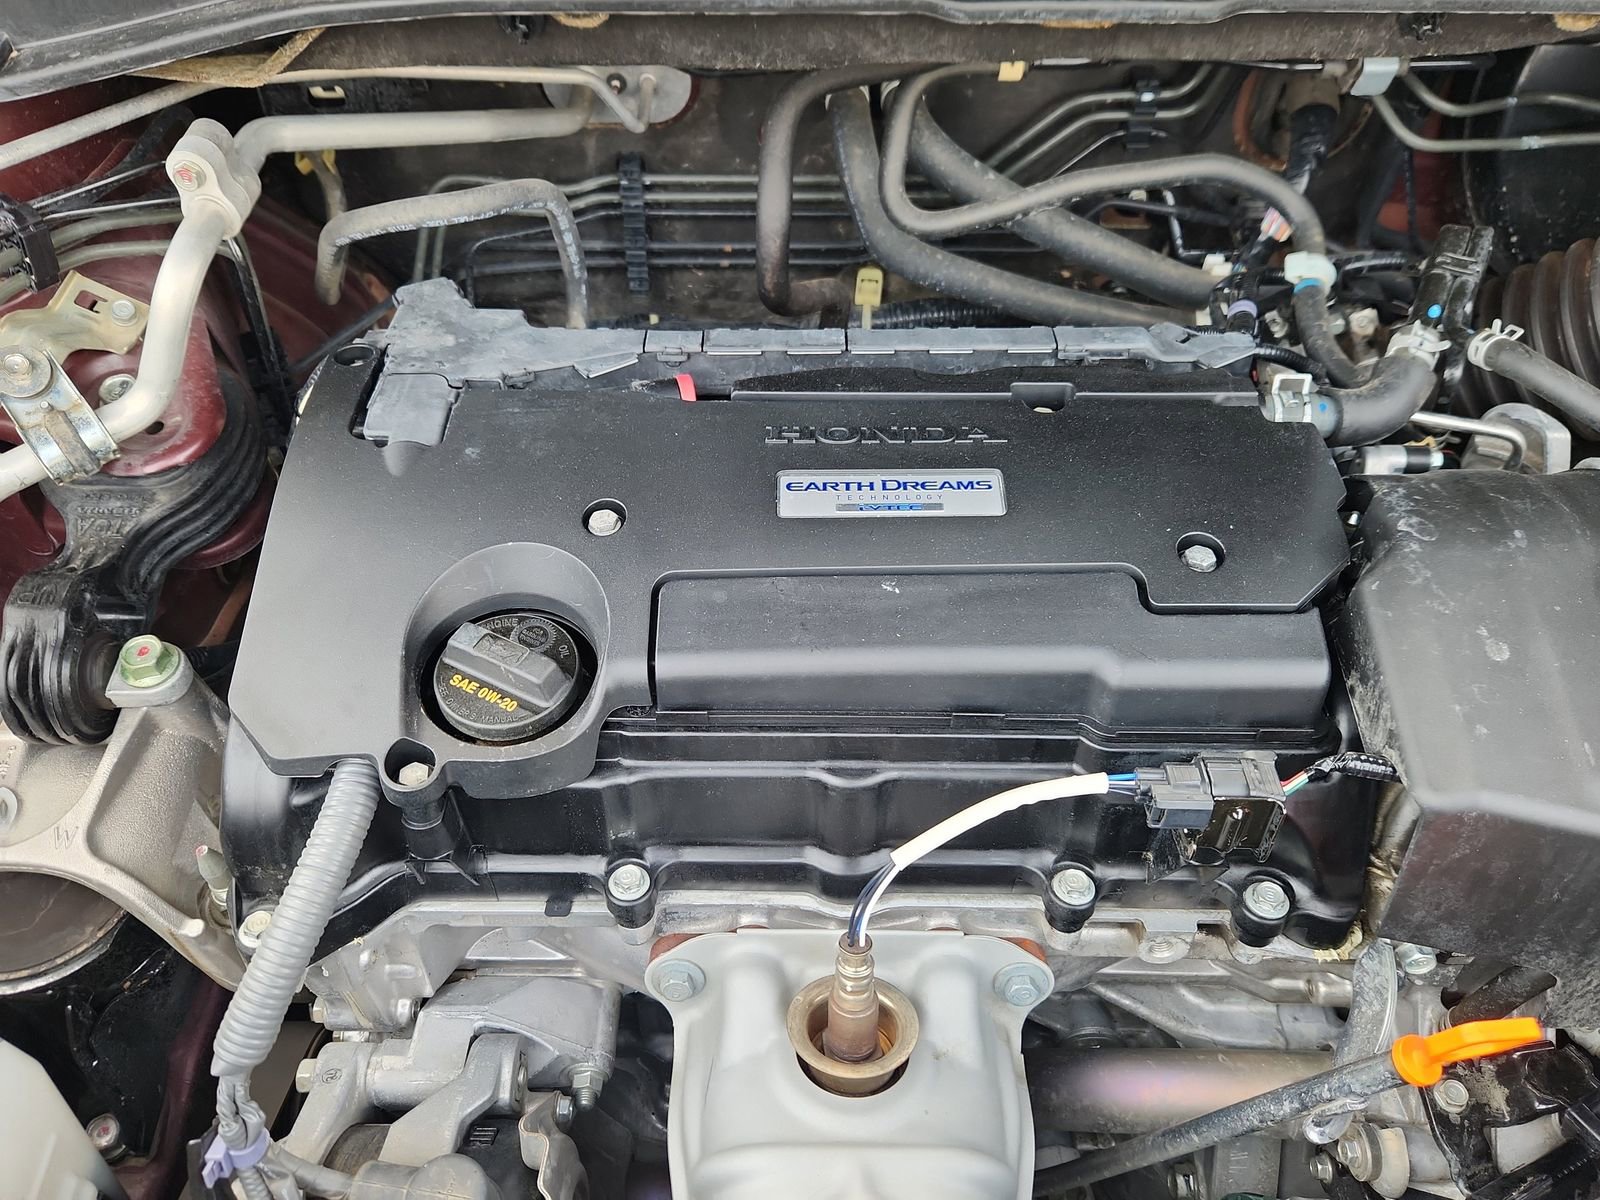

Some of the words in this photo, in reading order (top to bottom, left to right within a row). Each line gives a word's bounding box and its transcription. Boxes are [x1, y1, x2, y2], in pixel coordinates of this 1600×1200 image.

[764, 426, 1008, 444] HONDA
[785, 481, 875, 492] EARTH
[881, 480, 993, 491] DREAMS
[558, 644, 570, 659] OIL
[449, 674, 480, 694] SAE
[478, 687, 518, 712] 0W-20
[481, 714, 518, 724] MANUAL
